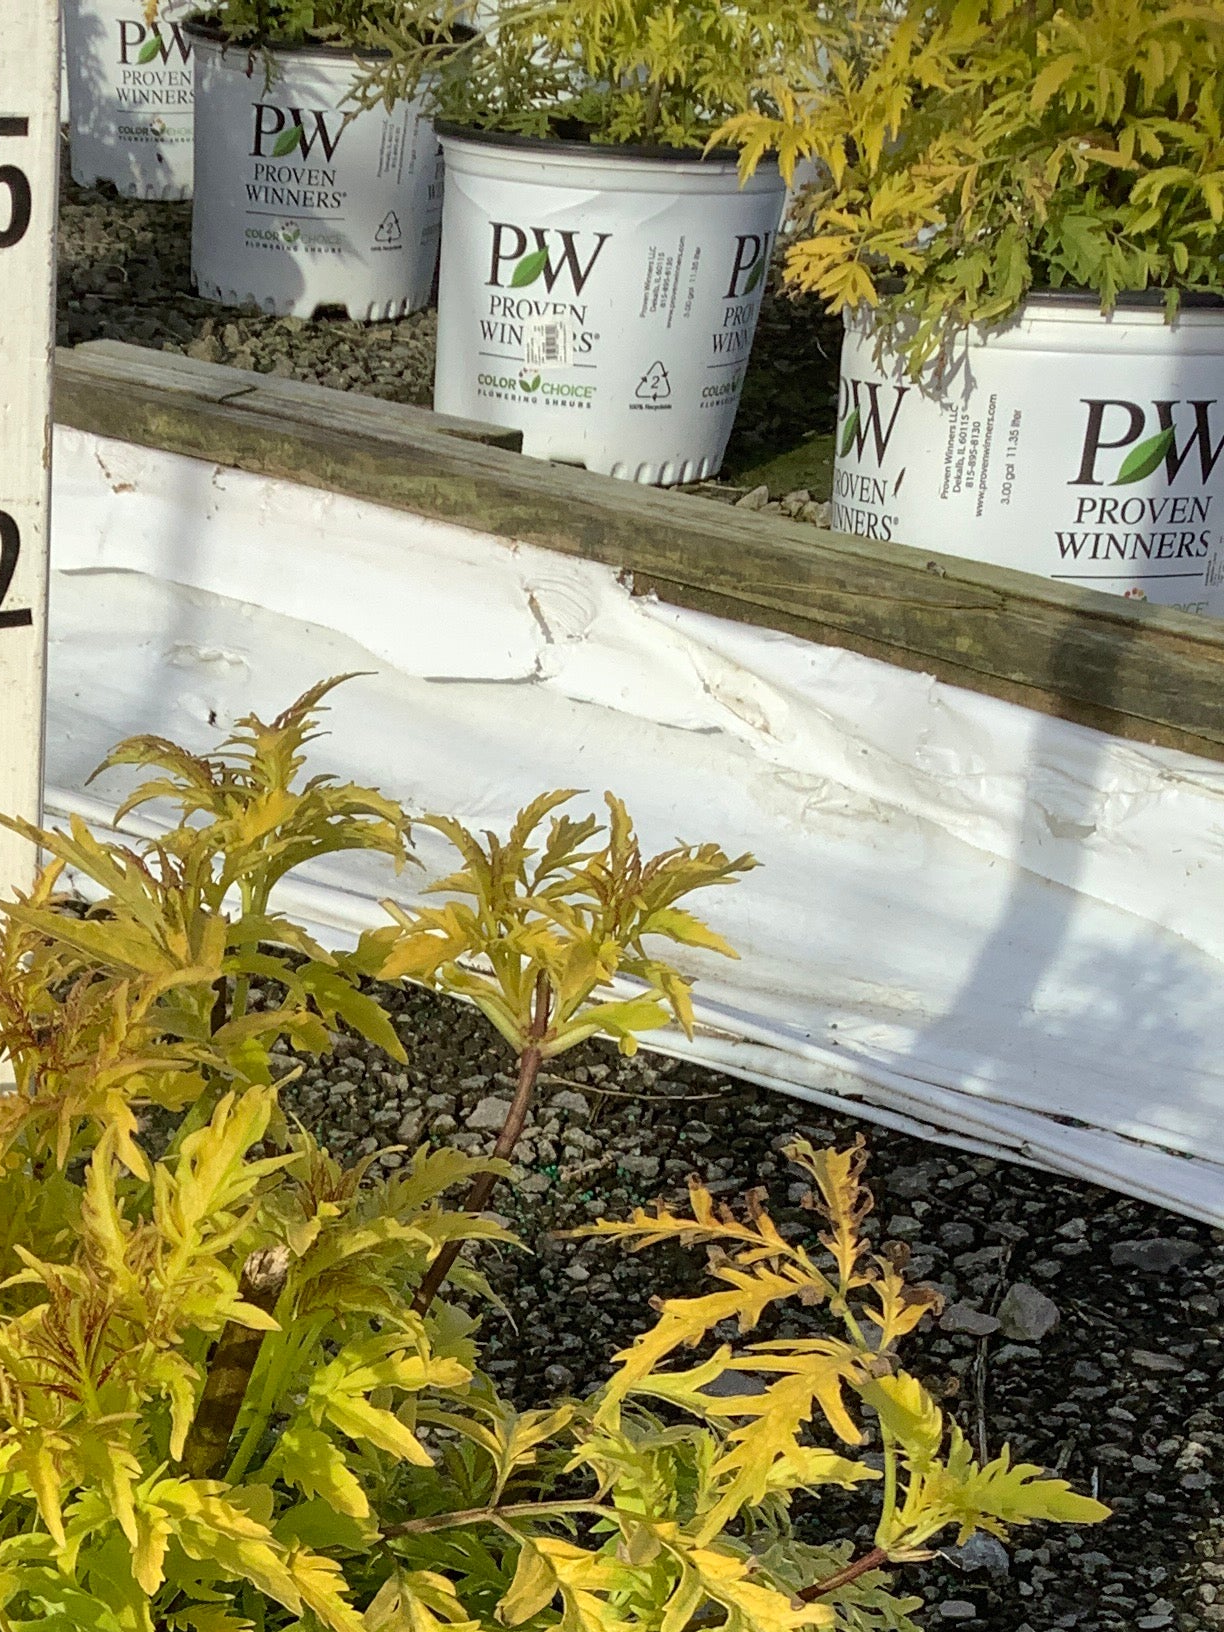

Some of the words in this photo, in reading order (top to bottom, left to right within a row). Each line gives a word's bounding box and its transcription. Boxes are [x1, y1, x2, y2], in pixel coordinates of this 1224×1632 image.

[122, 70, 192, 87] PROVEN
[249, 102, 353, 163] PW
[254, 162, 337, 187] PROVEN
[245, 228, 280, 242] COLOR
[484, 221, 613, 297] PW
[489, 294, 588, 327] PROVEN
[479, 320, 594, 353] WINS
[478, 373, 517, 391] COLOR
[541, 382, 593, 399] CHOICE
[650, 375, 661, 389] 2
[478, 388, 537, 404] FLOWERING
[545, 398, 592, 409] SHRUBS
[944, 425, 956, 465] Winners
[835, 467, 888, 507] ROVEN
[941, 466, 952, 499] Proven
[1073, 496, 1213, 524] PROVEN
[1054, 530, 1211, 560] WINNERS
